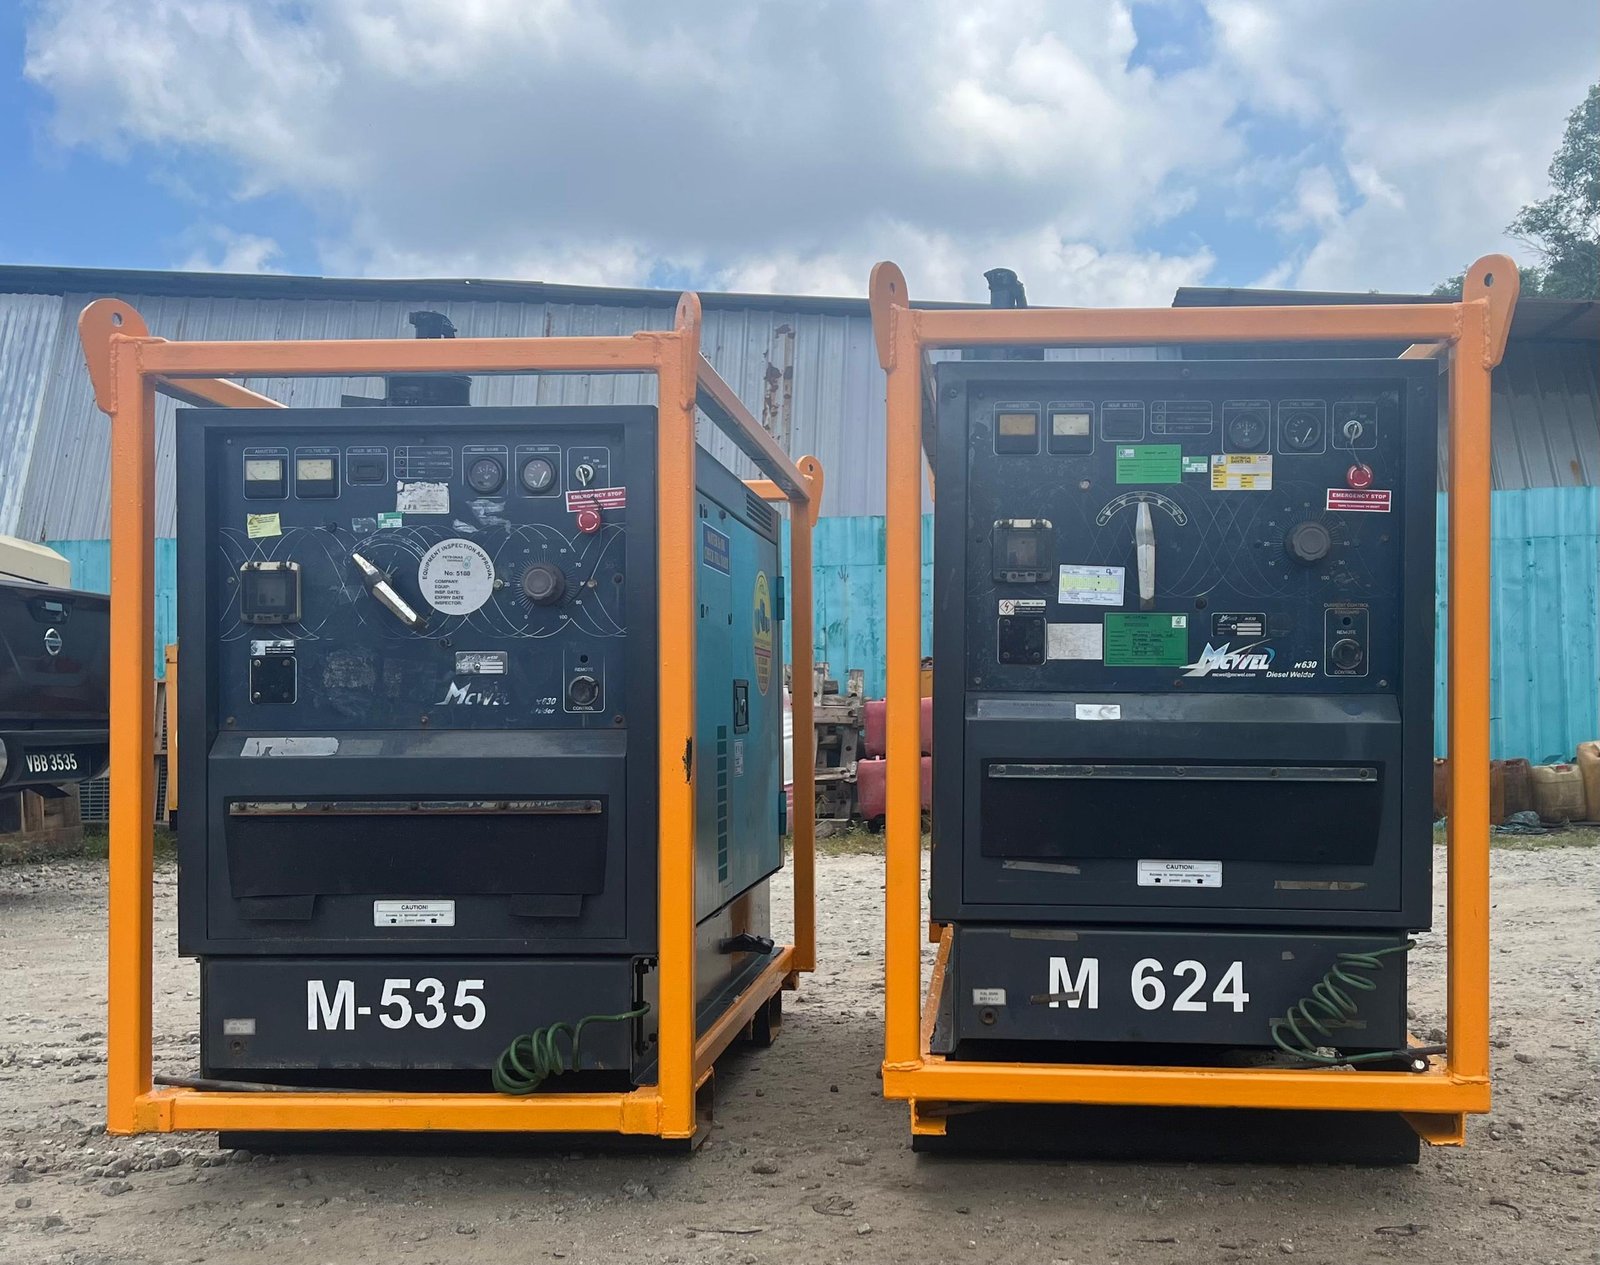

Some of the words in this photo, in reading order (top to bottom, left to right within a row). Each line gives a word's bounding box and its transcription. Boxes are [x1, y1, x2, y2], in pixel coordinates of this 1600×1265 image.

[570, 492, 606, 501] EMERGENCY
[607, 490, 623, 498] STOP
[422, 548, 441, 580] EQUIPMENT
[441, 542, 476, 553] INSPECTION
[476, 551, 493, 580] APPROVAL
[1265, 670, 1289, 678] Diesel
[1289, 670, 1316, 678] Welder
[26, 754, 49, 773] VBB
[50, 753, 77, 771] 3535
[1048, 956, 1099, 1009] M
[1130, 957, 1250, 1013] 624
[307, 976, 487, 1030] M-535
